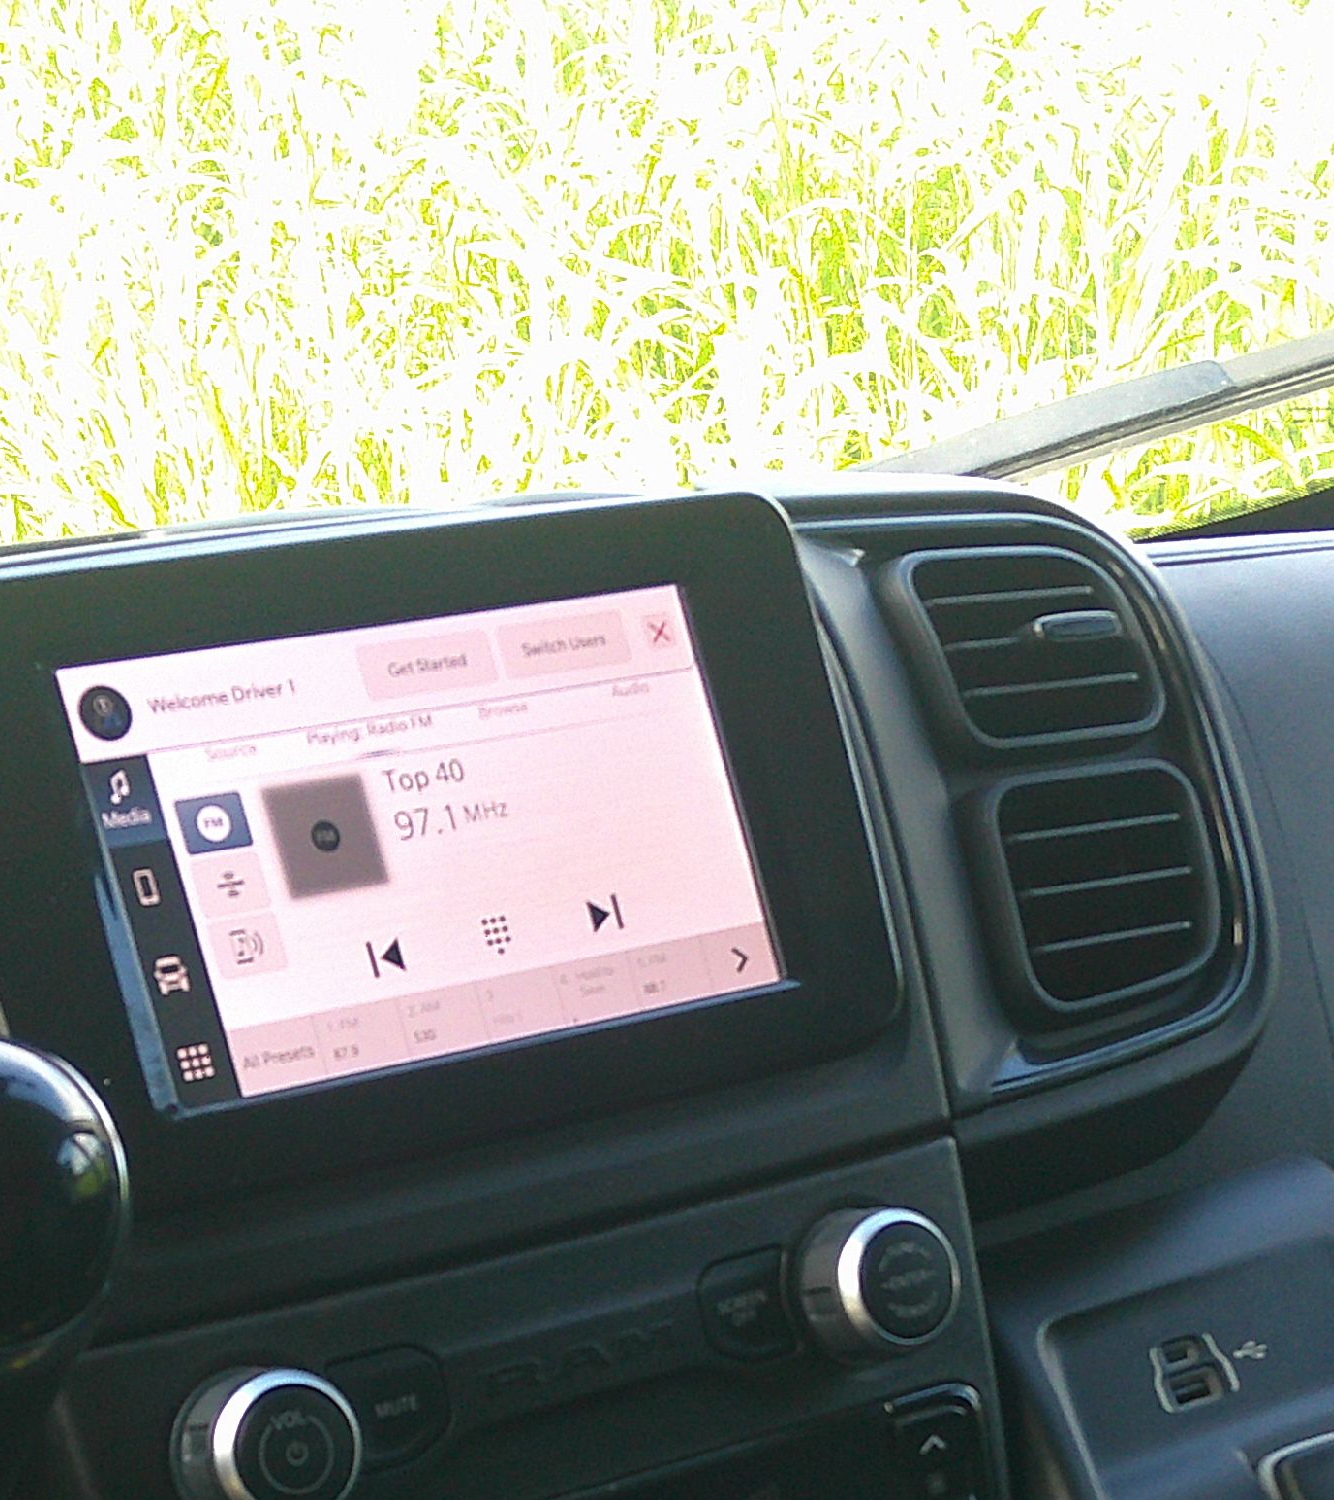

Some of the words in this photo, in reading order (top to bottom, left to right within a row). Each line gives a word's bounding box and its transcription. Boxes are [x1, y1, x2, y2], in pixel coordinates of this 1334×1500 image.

[521, 638, 567, 658] Switch
[569, 634, 607, 651] Users
[387, 660, 414, 678] Get
[417, 653, 468, 674] Started
[146, 689, 229, 715] Welcome
[231, 680, 283, 701] Driver
[612, 681, 650, 698] Audio
[477, 702, 529, 720] Browse
[366, 720, 408, 738] Radio
[383, 766, 431, 794] Top
[435, 758, 466, 784] 40
[101, 808, 153, 829] Media
[202, 817, 224, 829] FM
[393, 803, 459, 842] 97.1
[463, 799, 510, 824] MHz
[262, 1045, 316, 1066] Presets
[374, 1395, 418, 1418] MUTE
[270, 1411, 305, 1430] VOL
